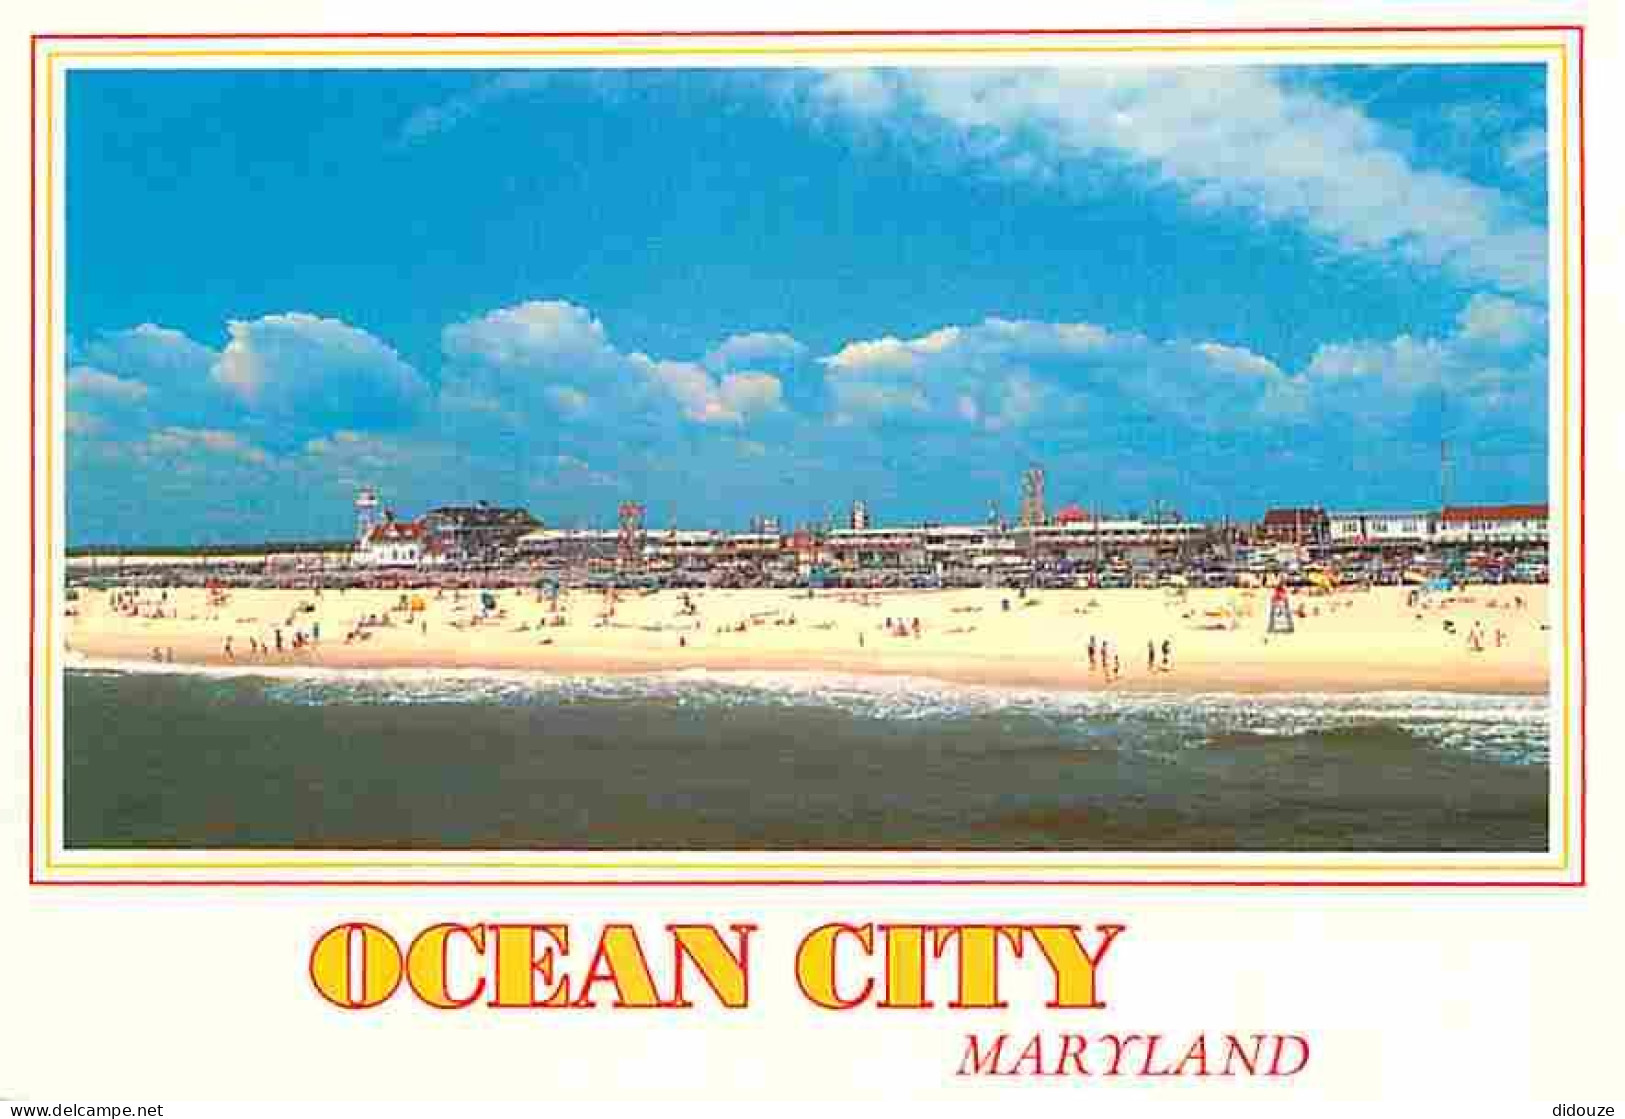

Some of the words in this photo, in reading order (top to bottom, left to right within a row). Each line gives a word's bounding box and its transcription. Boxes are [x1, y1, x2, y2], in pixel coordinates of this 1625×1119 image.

[309, 922, 758, 1010] OCEAN
[794, 922, 1126, 1010] CITY
[956, 1032, 1310, 1076] MARYLAND
